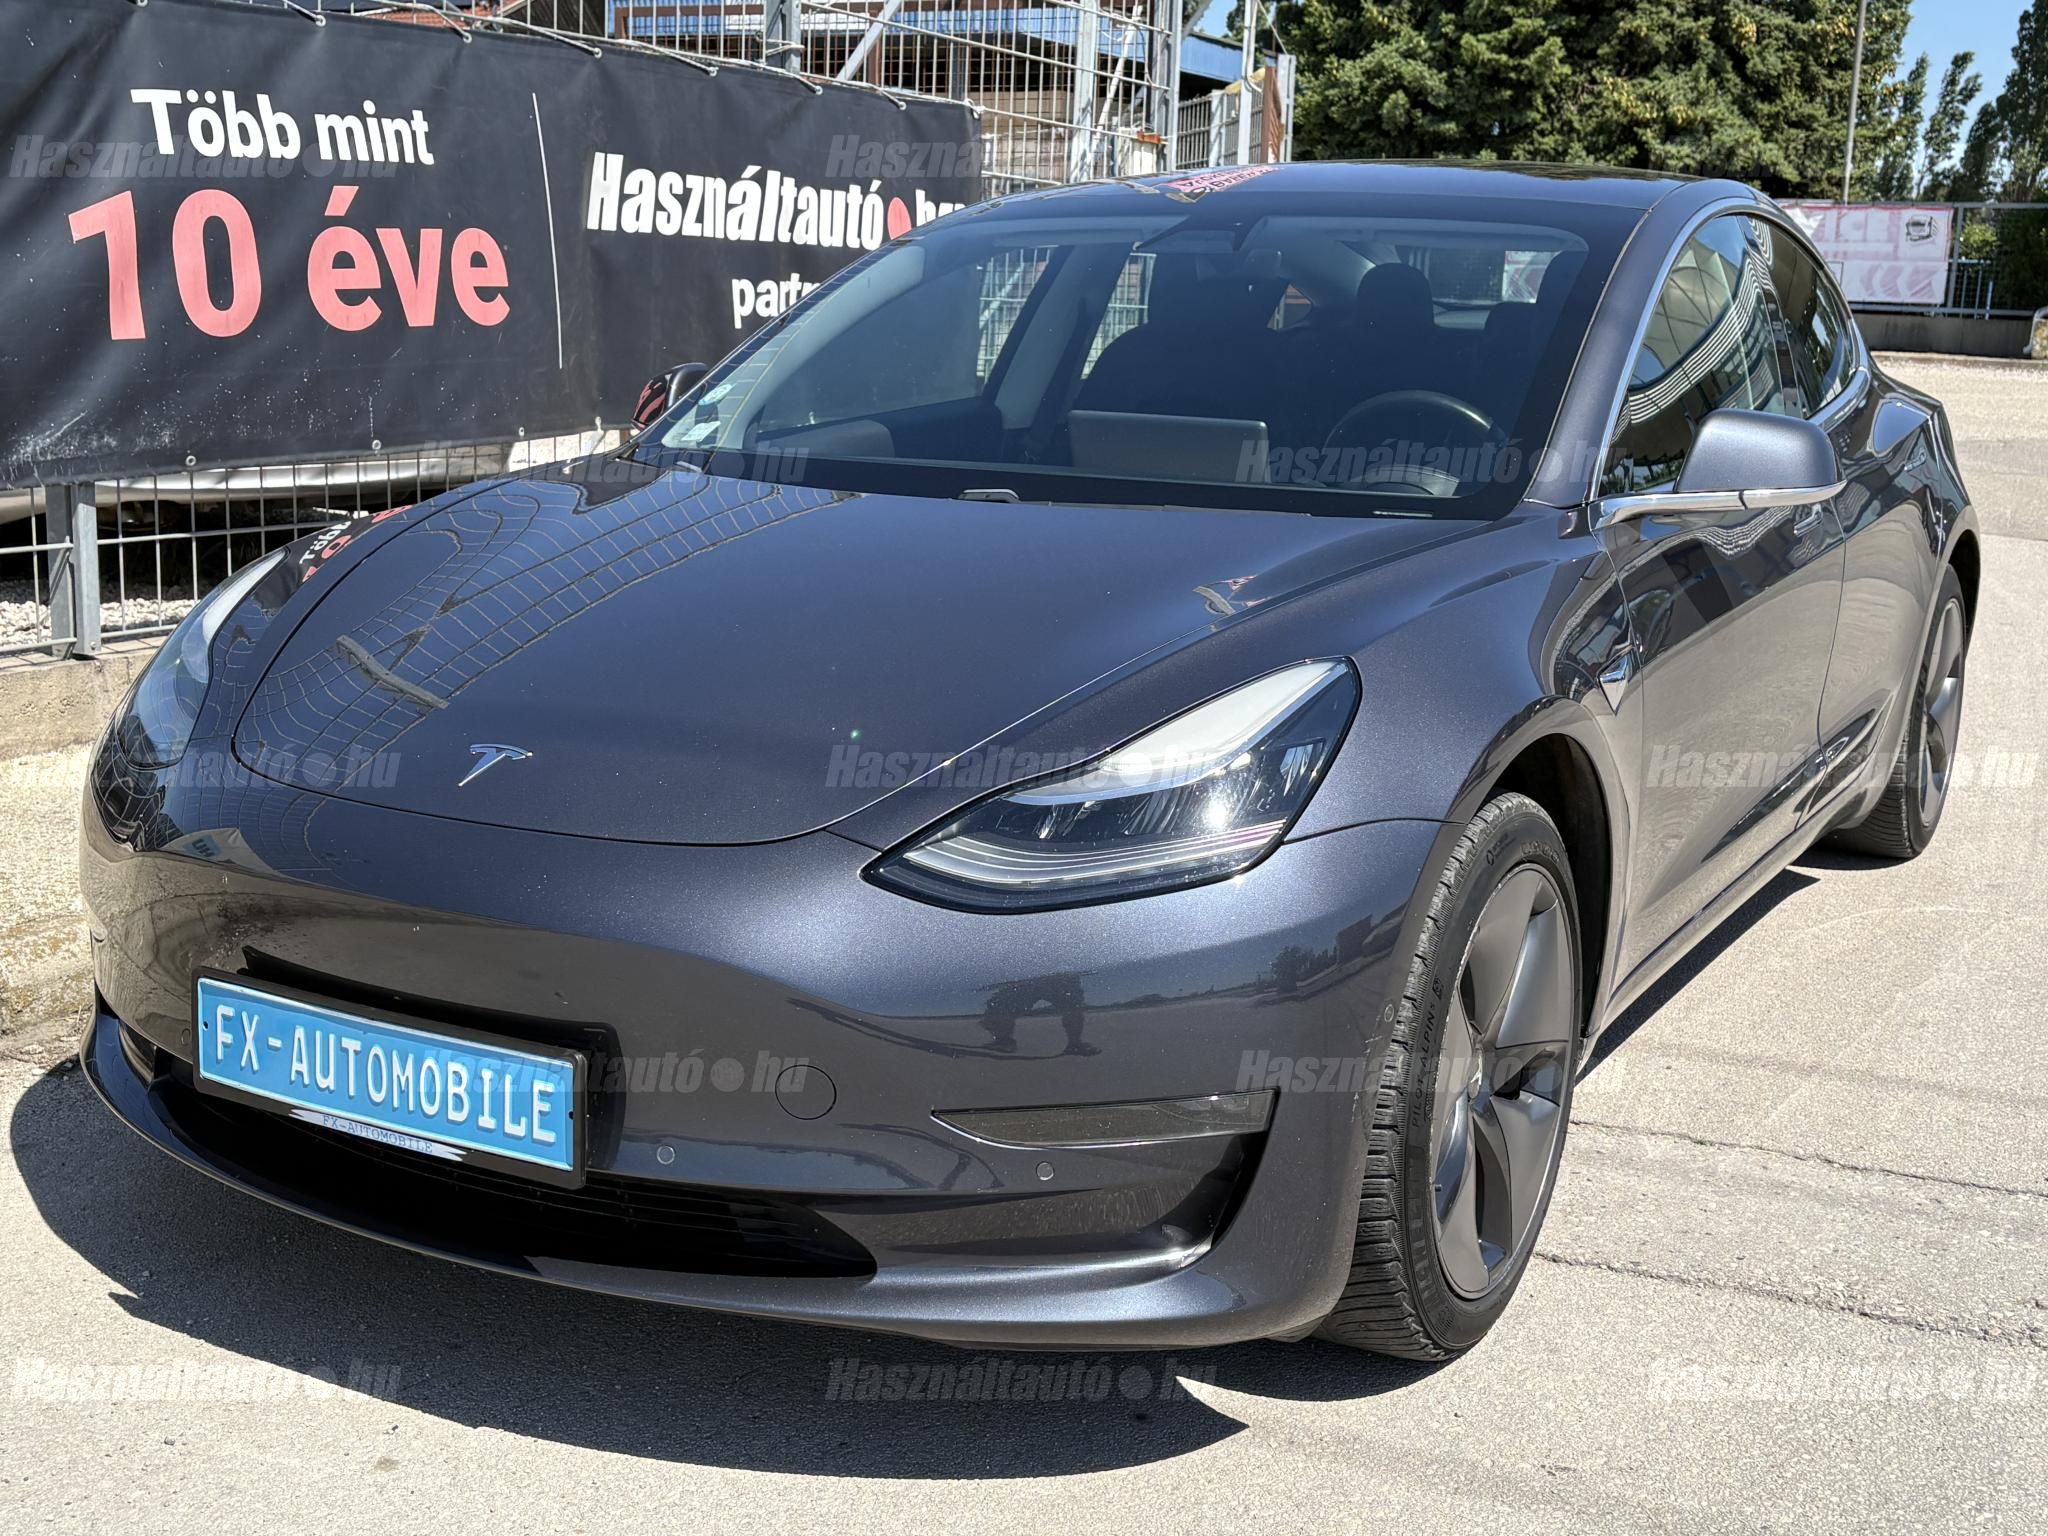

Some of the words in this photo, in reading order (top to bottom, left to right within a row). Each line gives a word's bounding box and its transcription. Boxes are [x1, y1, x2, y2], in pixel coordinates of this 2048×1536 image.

[131, 88, 301, 160] Több
[314, 99, 435, 166] mint
[68, 188, 262, 340] 10
[307, 185, 511, 332] éve
[214, 1003, 558, 1145] FX-AUTOMOBILE
[322, 1113, 434, 1154] FX-AUTOMOBILE
